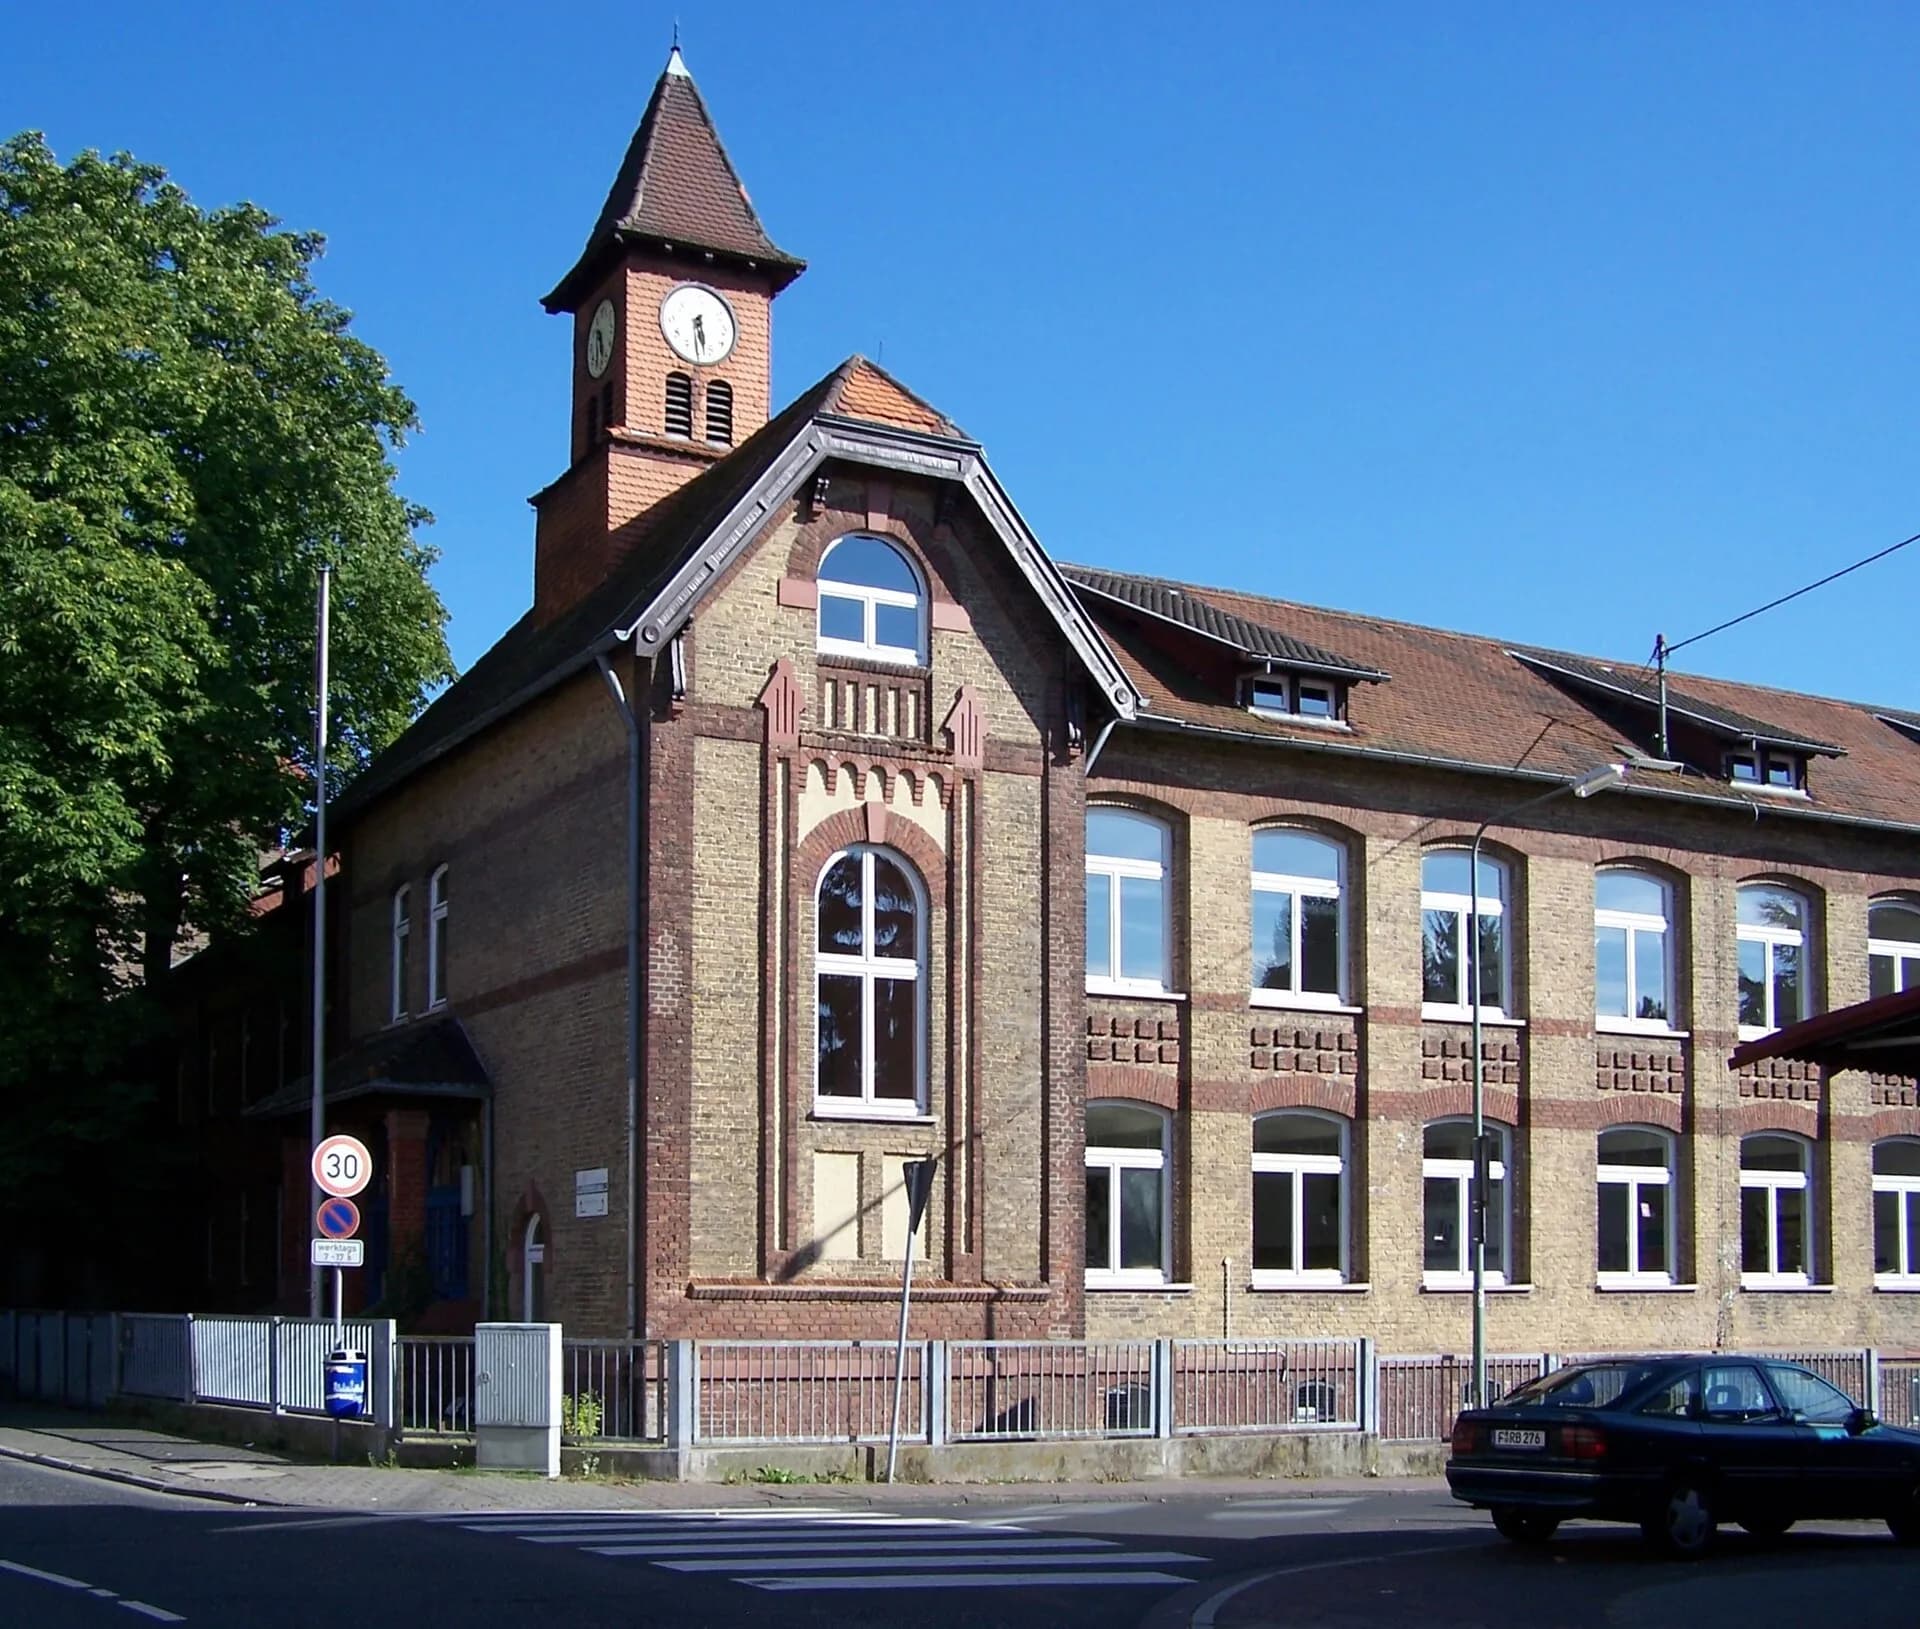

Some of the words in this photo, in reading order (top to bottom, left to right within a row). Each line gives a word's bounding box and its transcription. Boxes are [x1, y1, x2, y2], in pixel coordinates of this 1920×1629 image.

[327, 1153, 358, 1179] 30
[317, 1244, 357, 1253] werktags
[1523, 1432, 1541, 1445] 276
